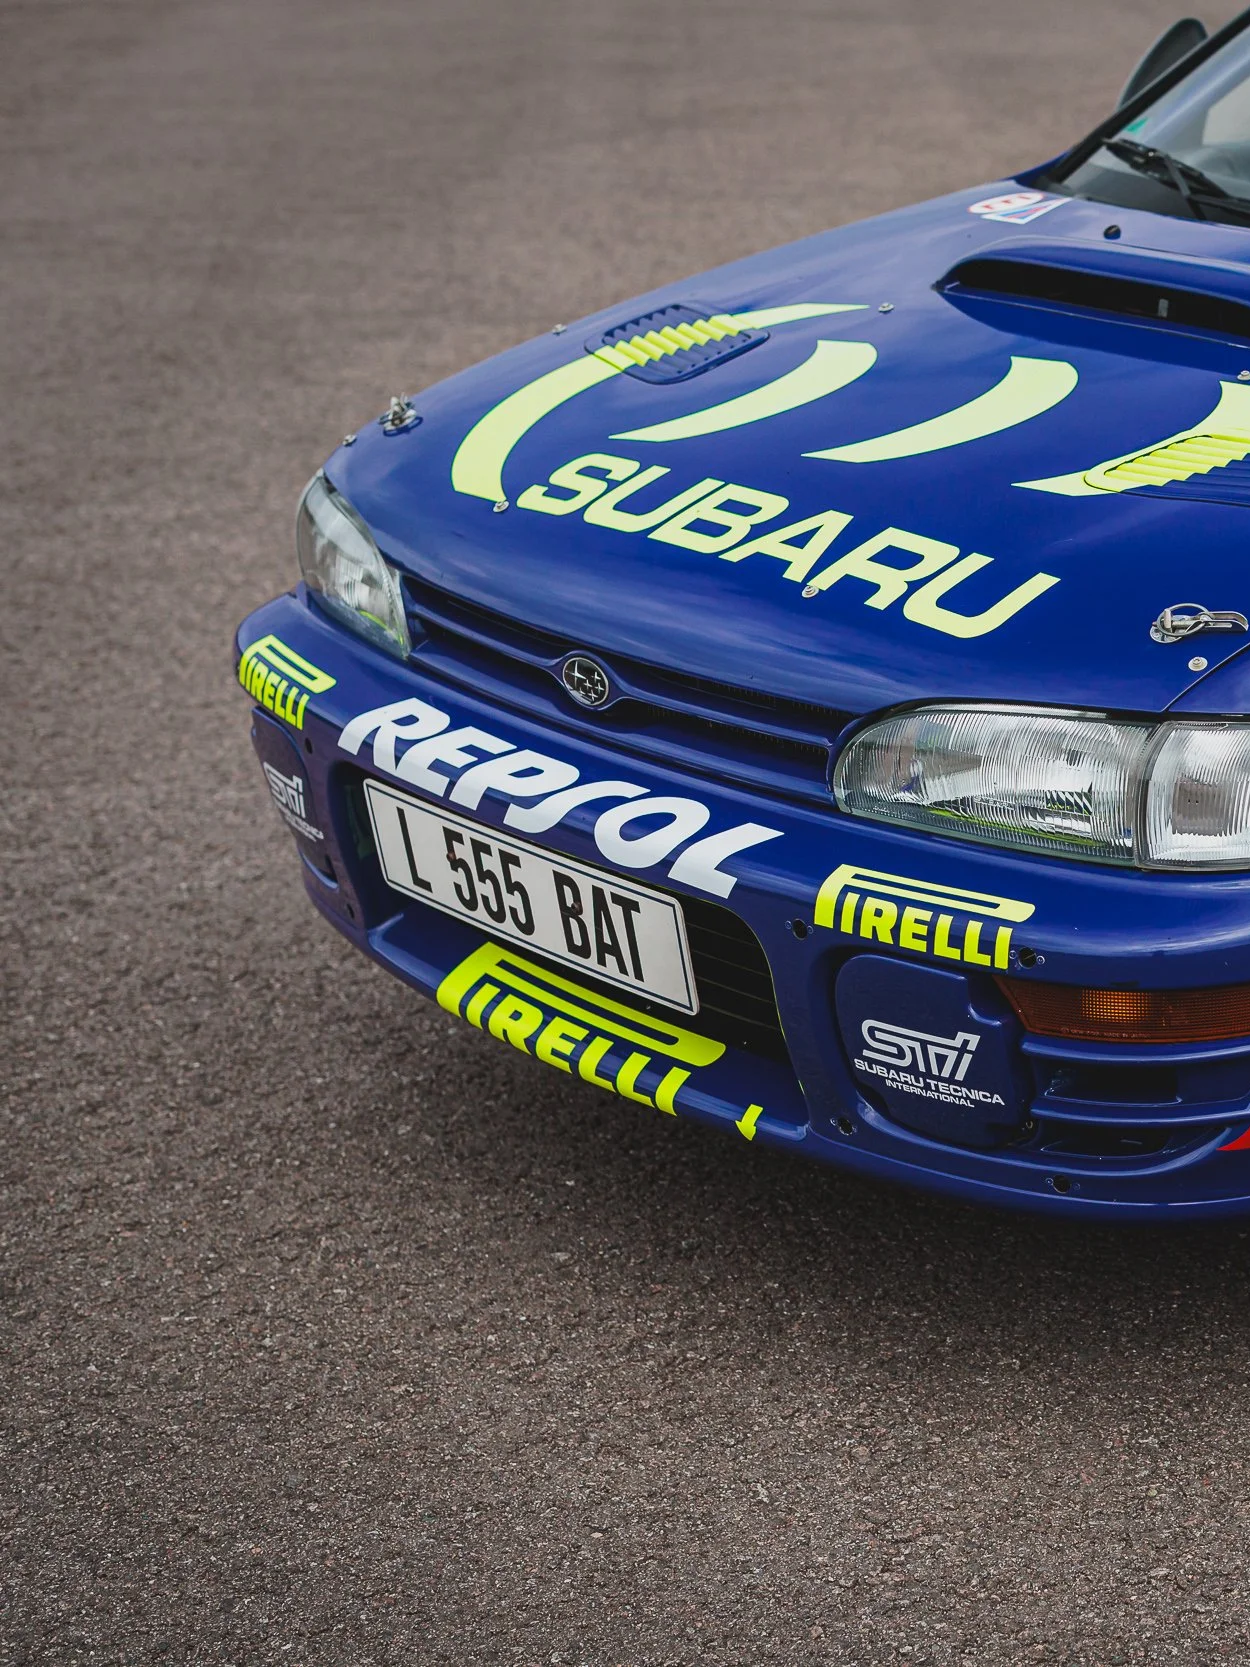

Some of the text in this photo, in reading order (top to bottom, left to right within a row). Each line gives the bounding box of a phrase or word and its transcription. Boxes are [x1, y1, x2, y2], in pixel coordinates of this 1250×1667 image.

[516, 452, 1061, 639] SUBARU
[239, 634, 337, 730] PIRELLI
[337, 697, 785, 899] REPSOL
[396, 807, 642, 983] L 555 BAT
[814, 863, 1036, 970] PIRELLI
[437, 941, 727, 1117] PIRELLI
[854, 1058, 1005, 1106] SUBARU TECNICA
[885, 1079, 975, 1107] INTERNATIONAL
